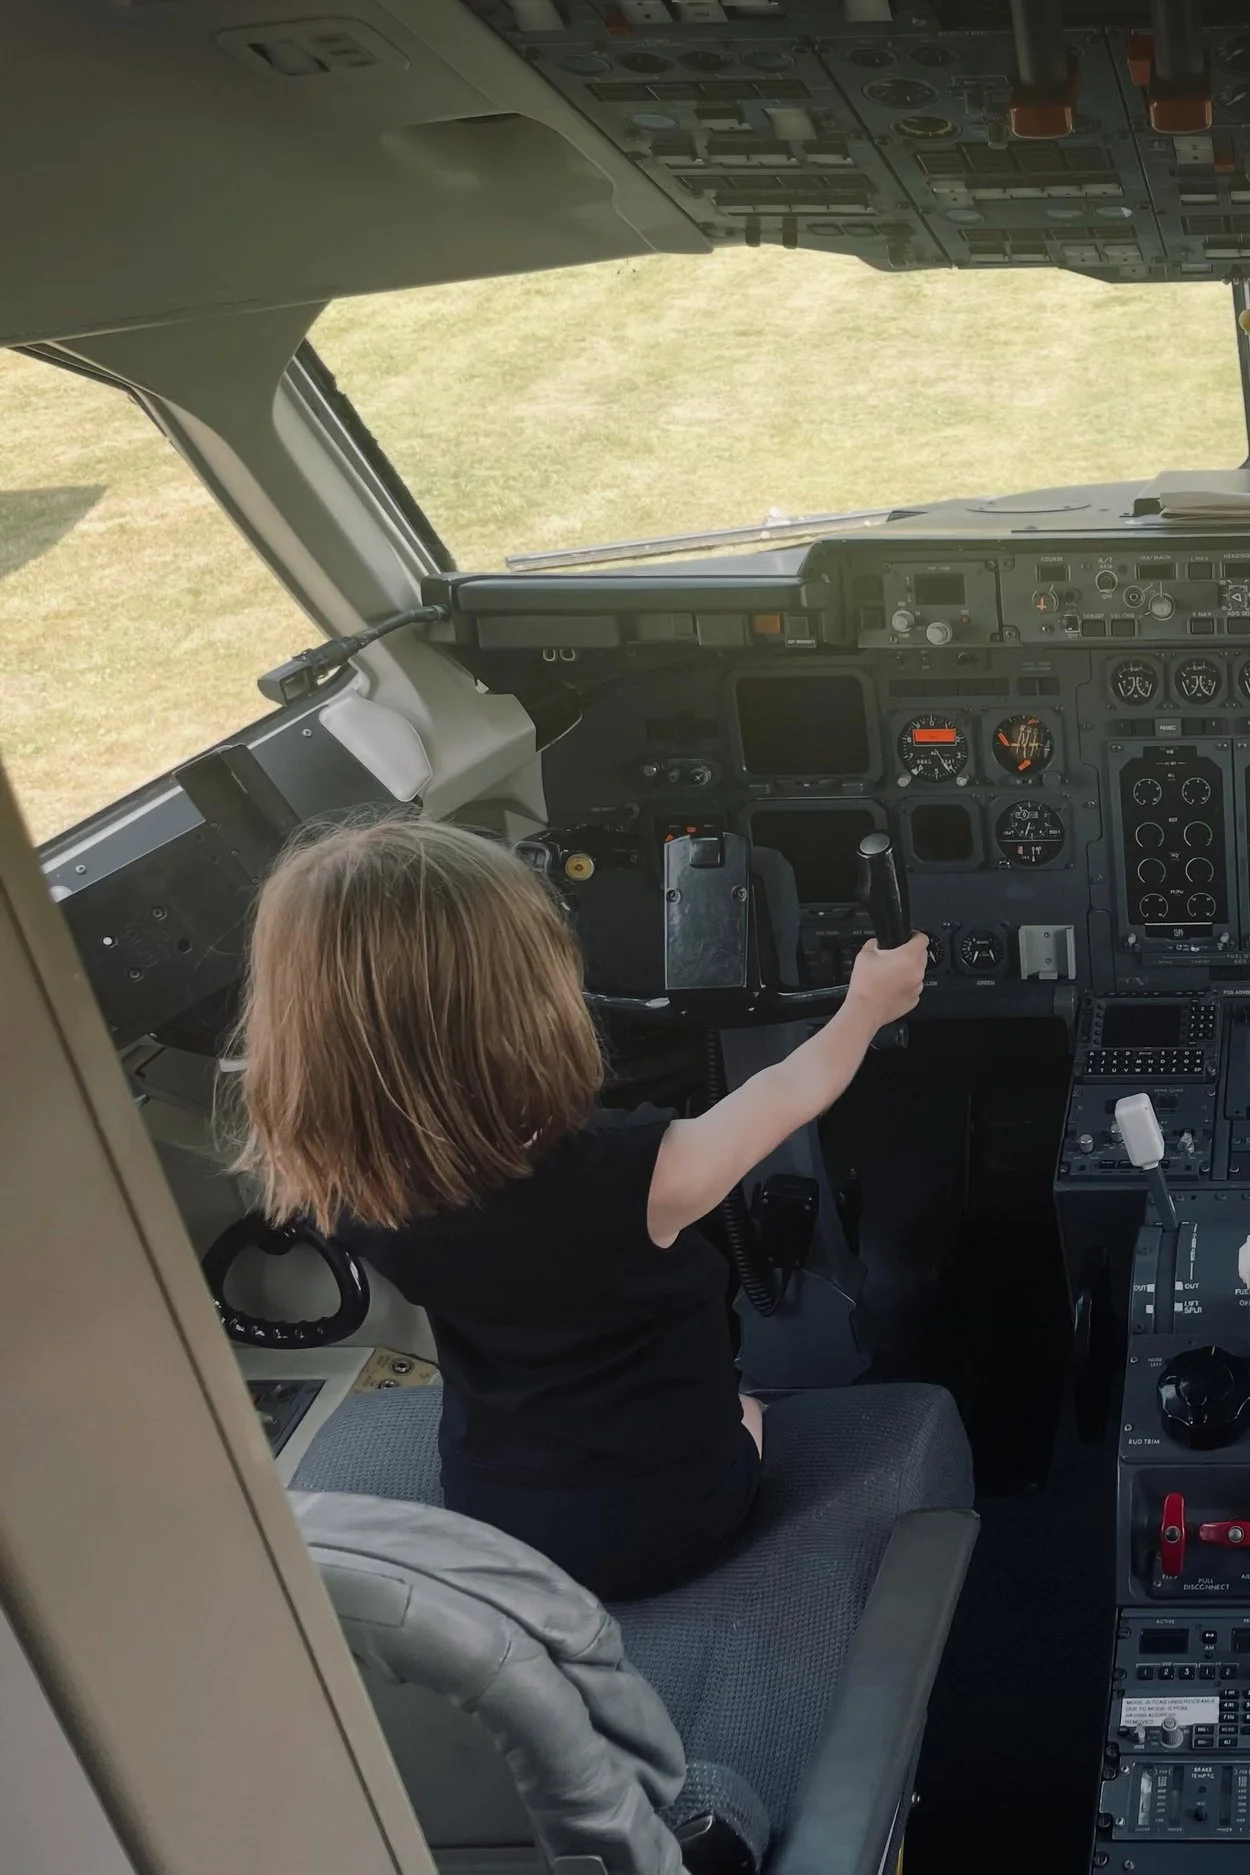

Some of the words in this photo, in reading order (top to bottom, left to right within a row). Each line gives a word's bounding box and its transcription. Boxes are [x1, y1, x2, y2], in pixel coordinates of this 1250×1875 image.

[1133, 1284, 1148, 1292] OUT
[1184, 1282, 1200, 1290] OUT
[1183, 1300, 1200, 1308] LIFT
[1183, 1306, 1203, 1314] SPLR
[1197, 1577, 1214, 1585] PULL
[1183, 1583, 1230, 1591] DISCONNECT
[1193, 1766, 1213, 1774] BRAKE
